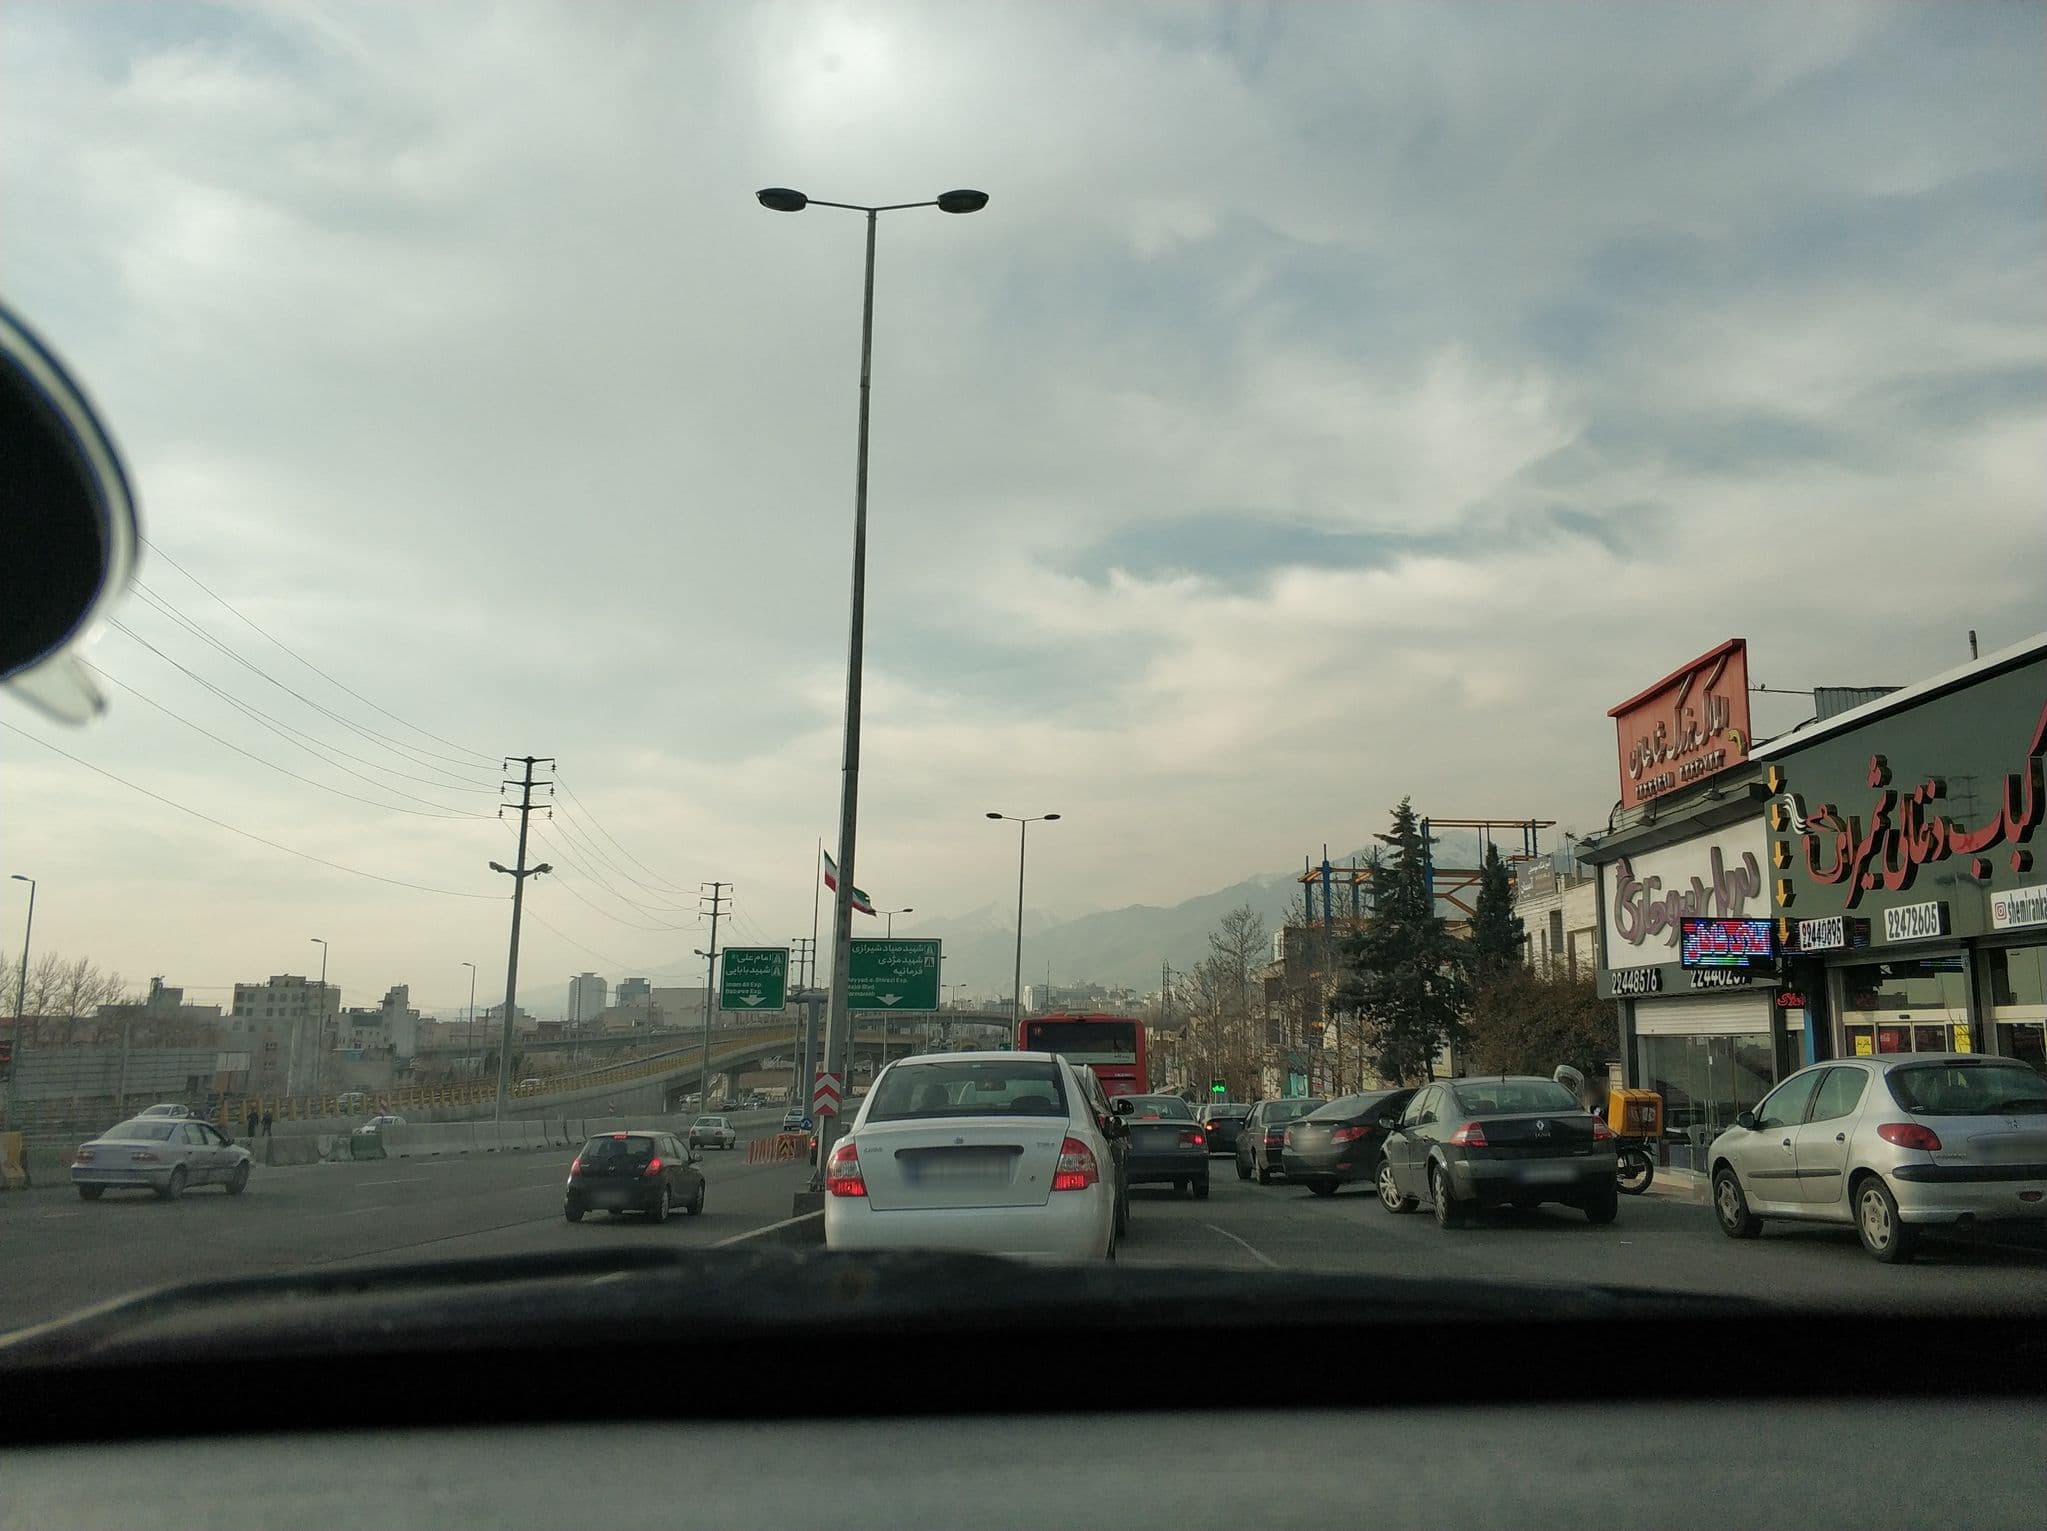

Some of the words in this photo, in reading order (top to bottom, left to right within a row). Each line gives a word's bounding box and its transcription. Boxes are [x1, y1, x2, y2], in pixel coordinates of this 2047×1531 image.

[1666, 670, 1699, 760] بزرگ
[1948, 697, 2047, 880] کباب
[2007, 887, 2047, 925] shemiranka
[1888, 904, 1937, 939] 22472605
[1802, 918, 1842, 948] 22440895
[852, 944, 881, 954] شیرازی
[882, 944, 903, 954] صیاد
[903, 944, 924, 954] شهید
[737, 953, 754, 963] علی
[753, 954, 772, 964] امام
[902, 955, 924, 965] شهید
[750, 965, 771, 975] شهید
[893, 966, 924, 977] فرمانیه
